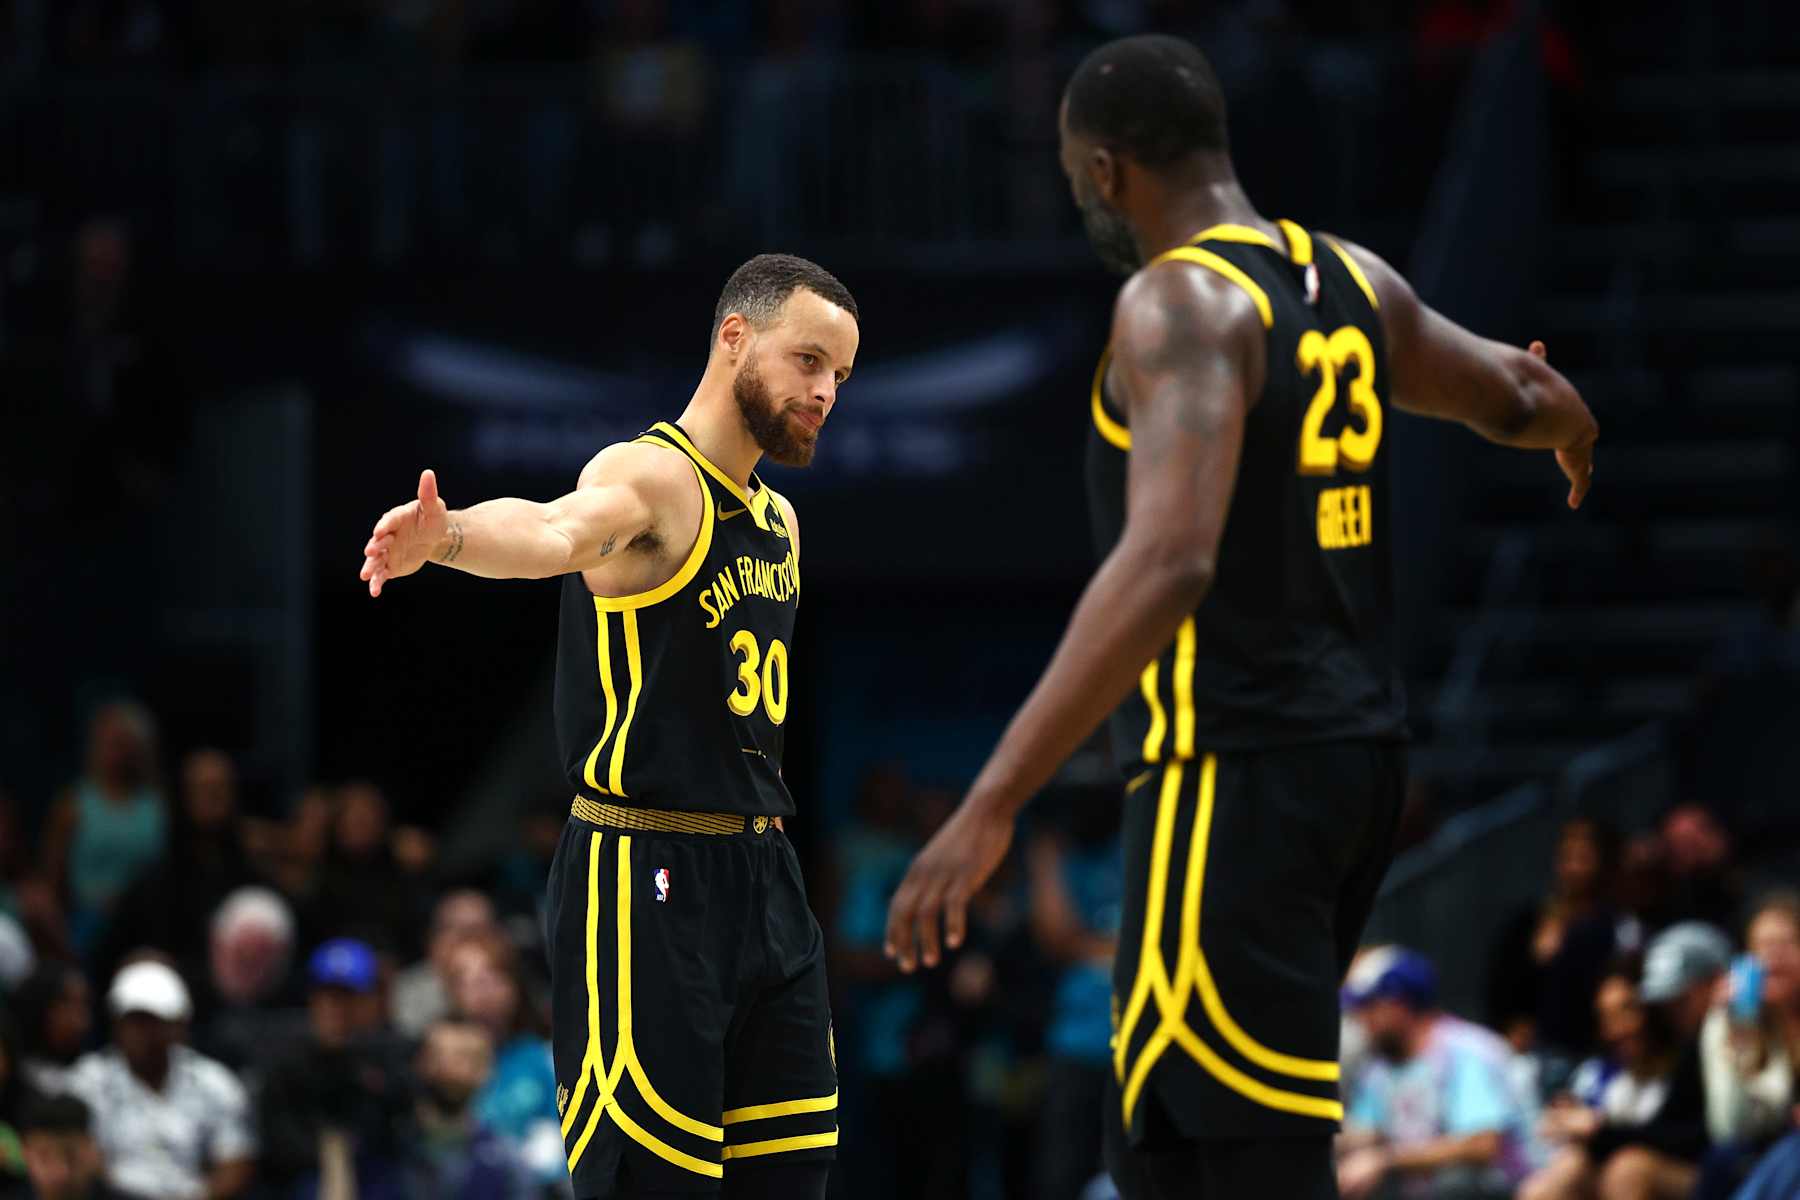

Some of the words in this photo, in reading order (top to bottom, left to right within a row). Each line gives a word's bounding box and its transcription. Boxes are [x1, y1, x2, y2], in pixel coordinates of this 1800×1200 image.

[1297, 325, 1383, 476] 23
[699, 566, 740, 628] SAN
[727, 629, 788, 725] 30
